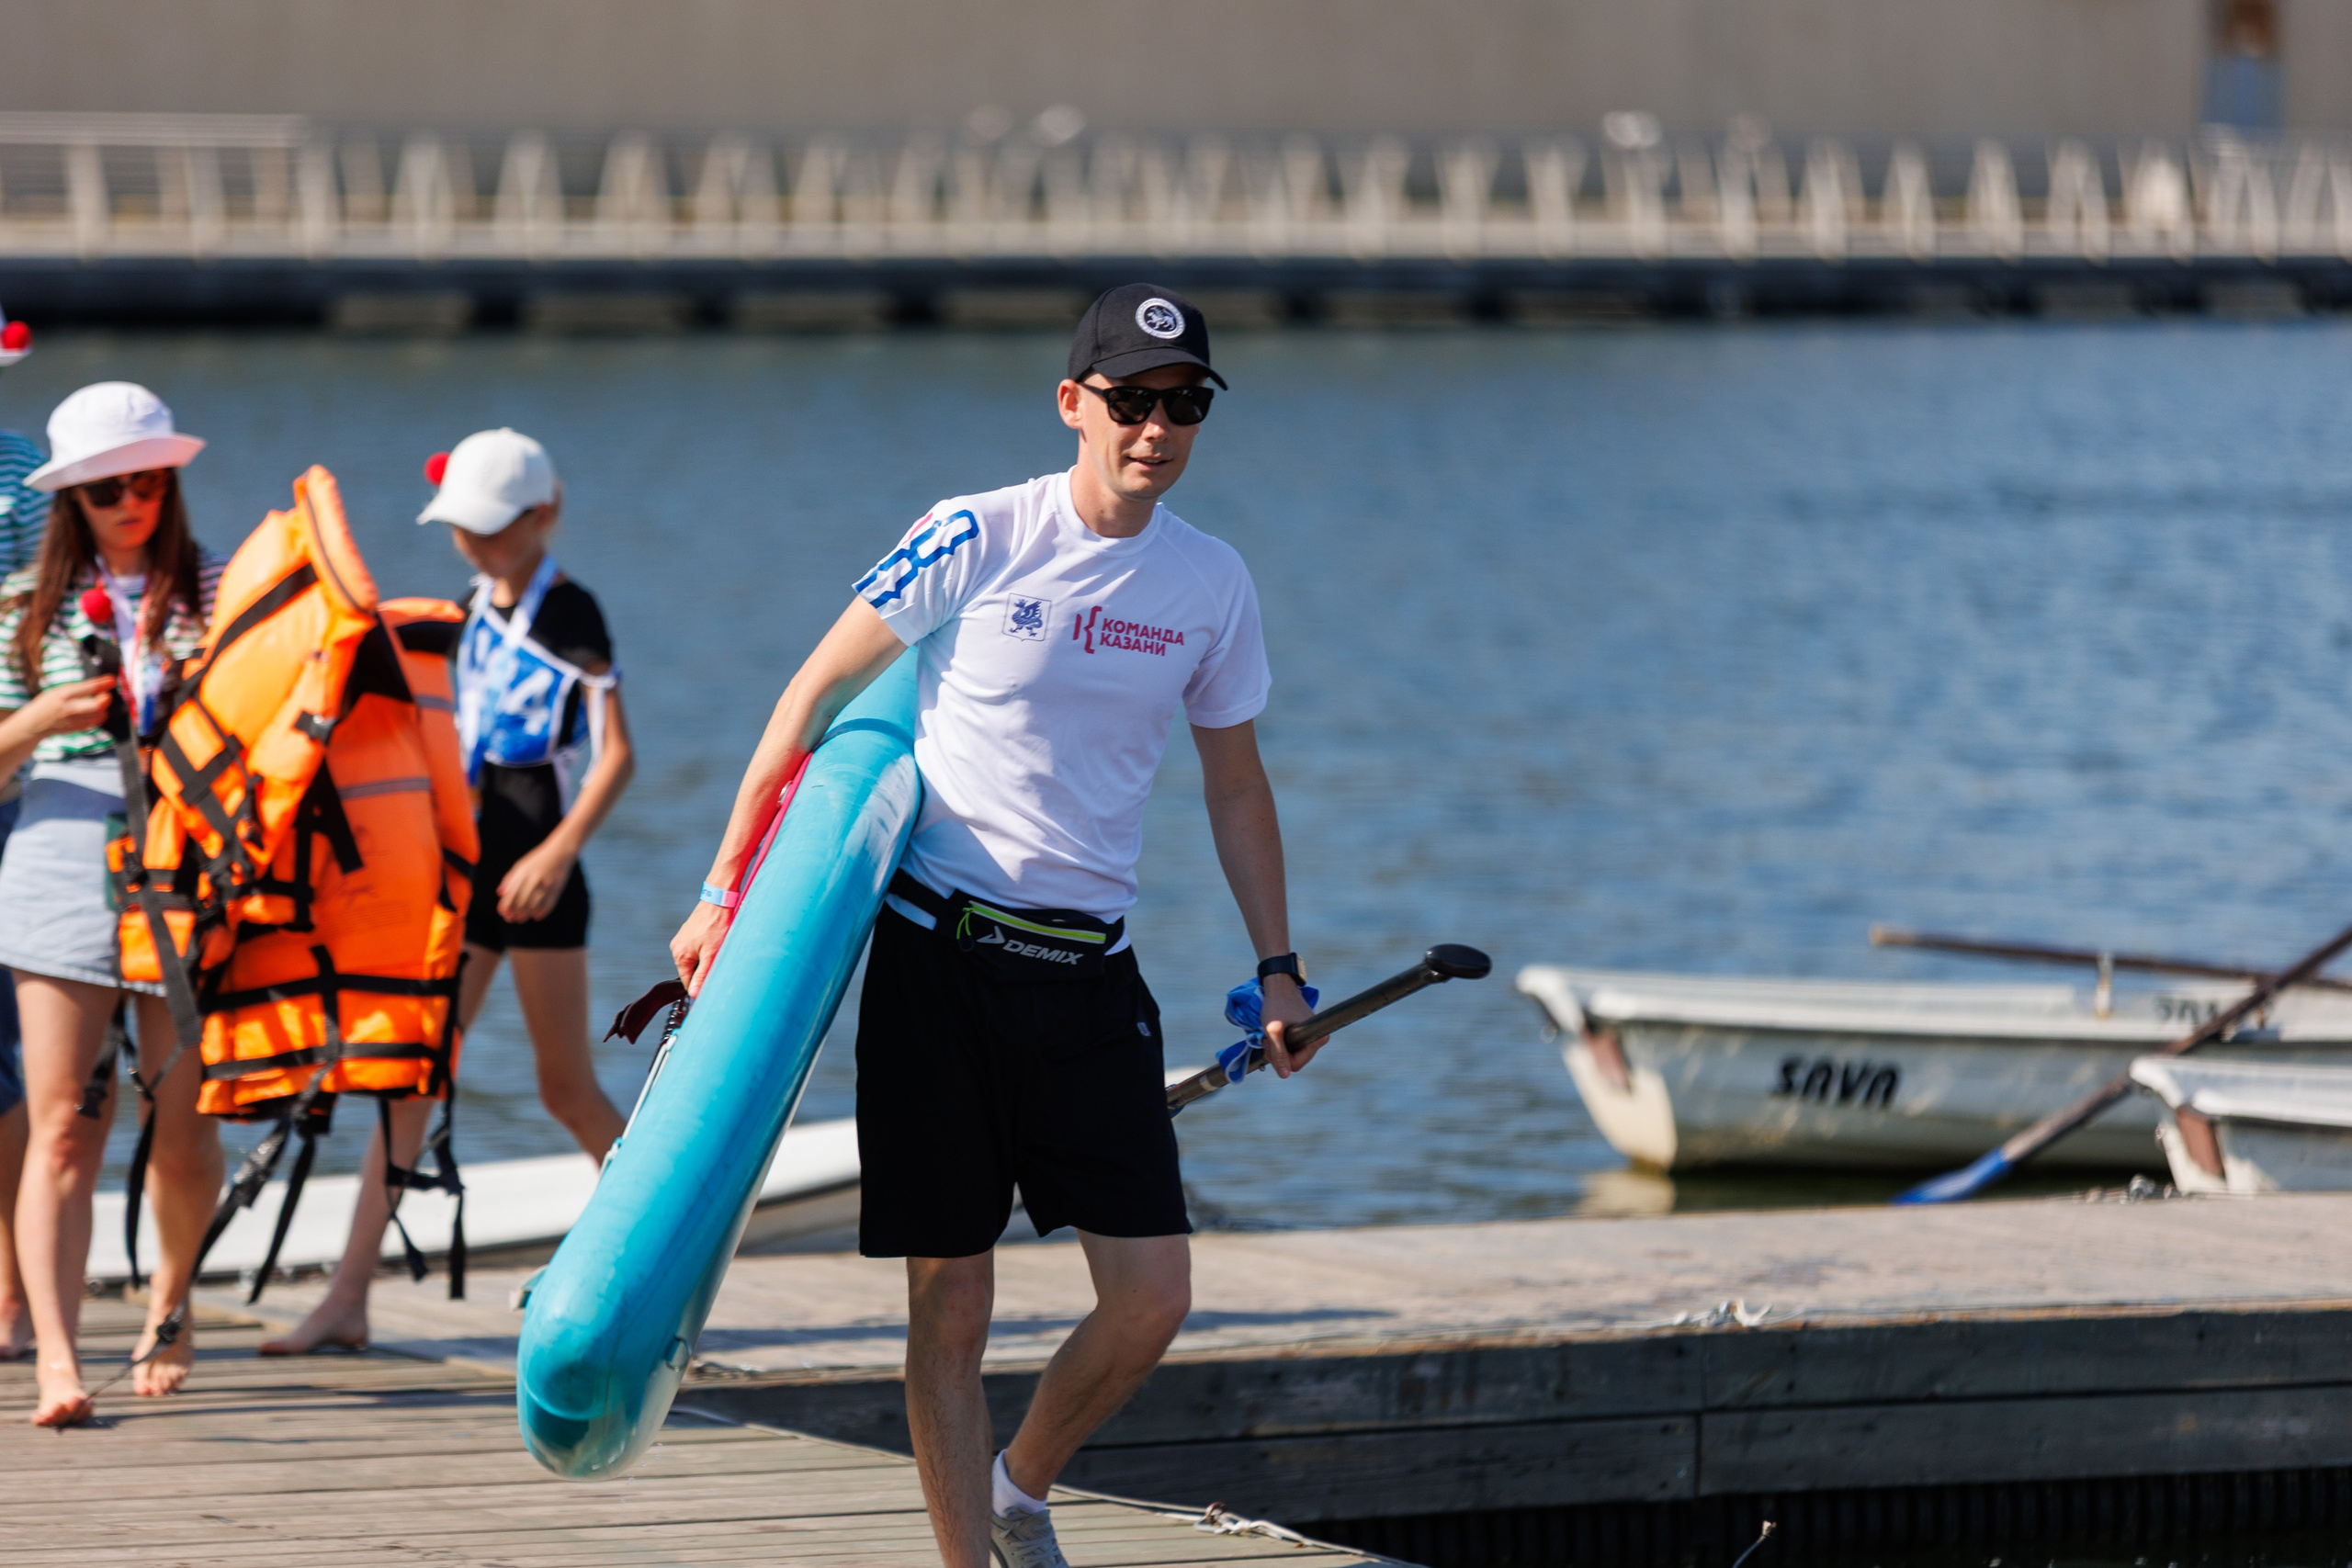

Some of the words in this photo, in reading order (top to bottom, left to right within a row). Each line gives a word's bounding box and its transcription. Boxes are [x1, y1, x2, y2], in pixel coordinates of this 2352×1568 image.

[1099, 632, 1166, 656] КАЗАНИ
[1102, 617, 1184, 646] КОМАНДА
[1002, 939, 1085, 965] DEMIX
[1770, 1054, 1901, 1108] SAVA
